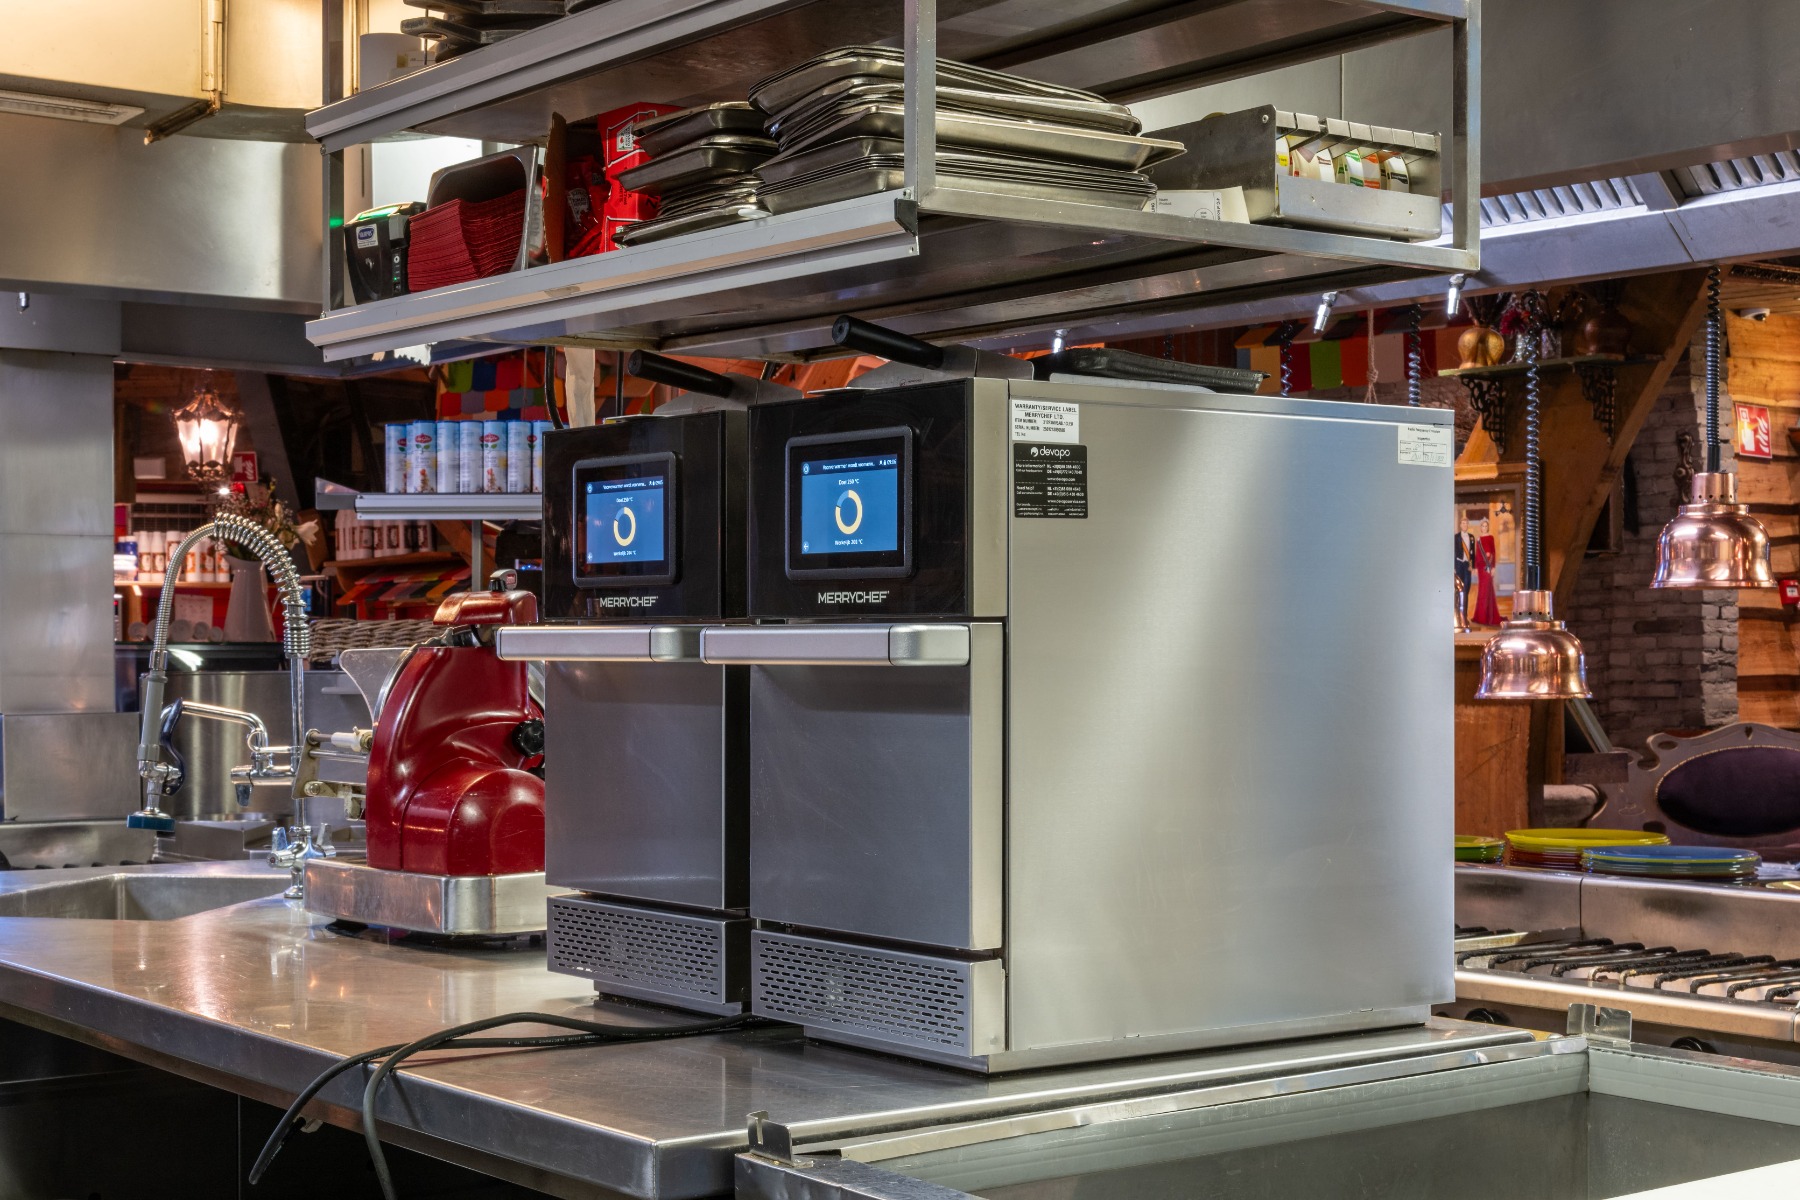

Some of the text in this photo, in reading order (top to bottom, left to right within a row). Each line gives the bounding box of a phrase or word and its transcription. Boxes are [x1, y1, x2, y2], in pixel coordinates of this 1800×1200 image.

[1040, 446, 1070, 459] devapo
[600, 596, 657, 608] MERRYCHEF
[818, 591, 888, 604] MERRYCHEF
